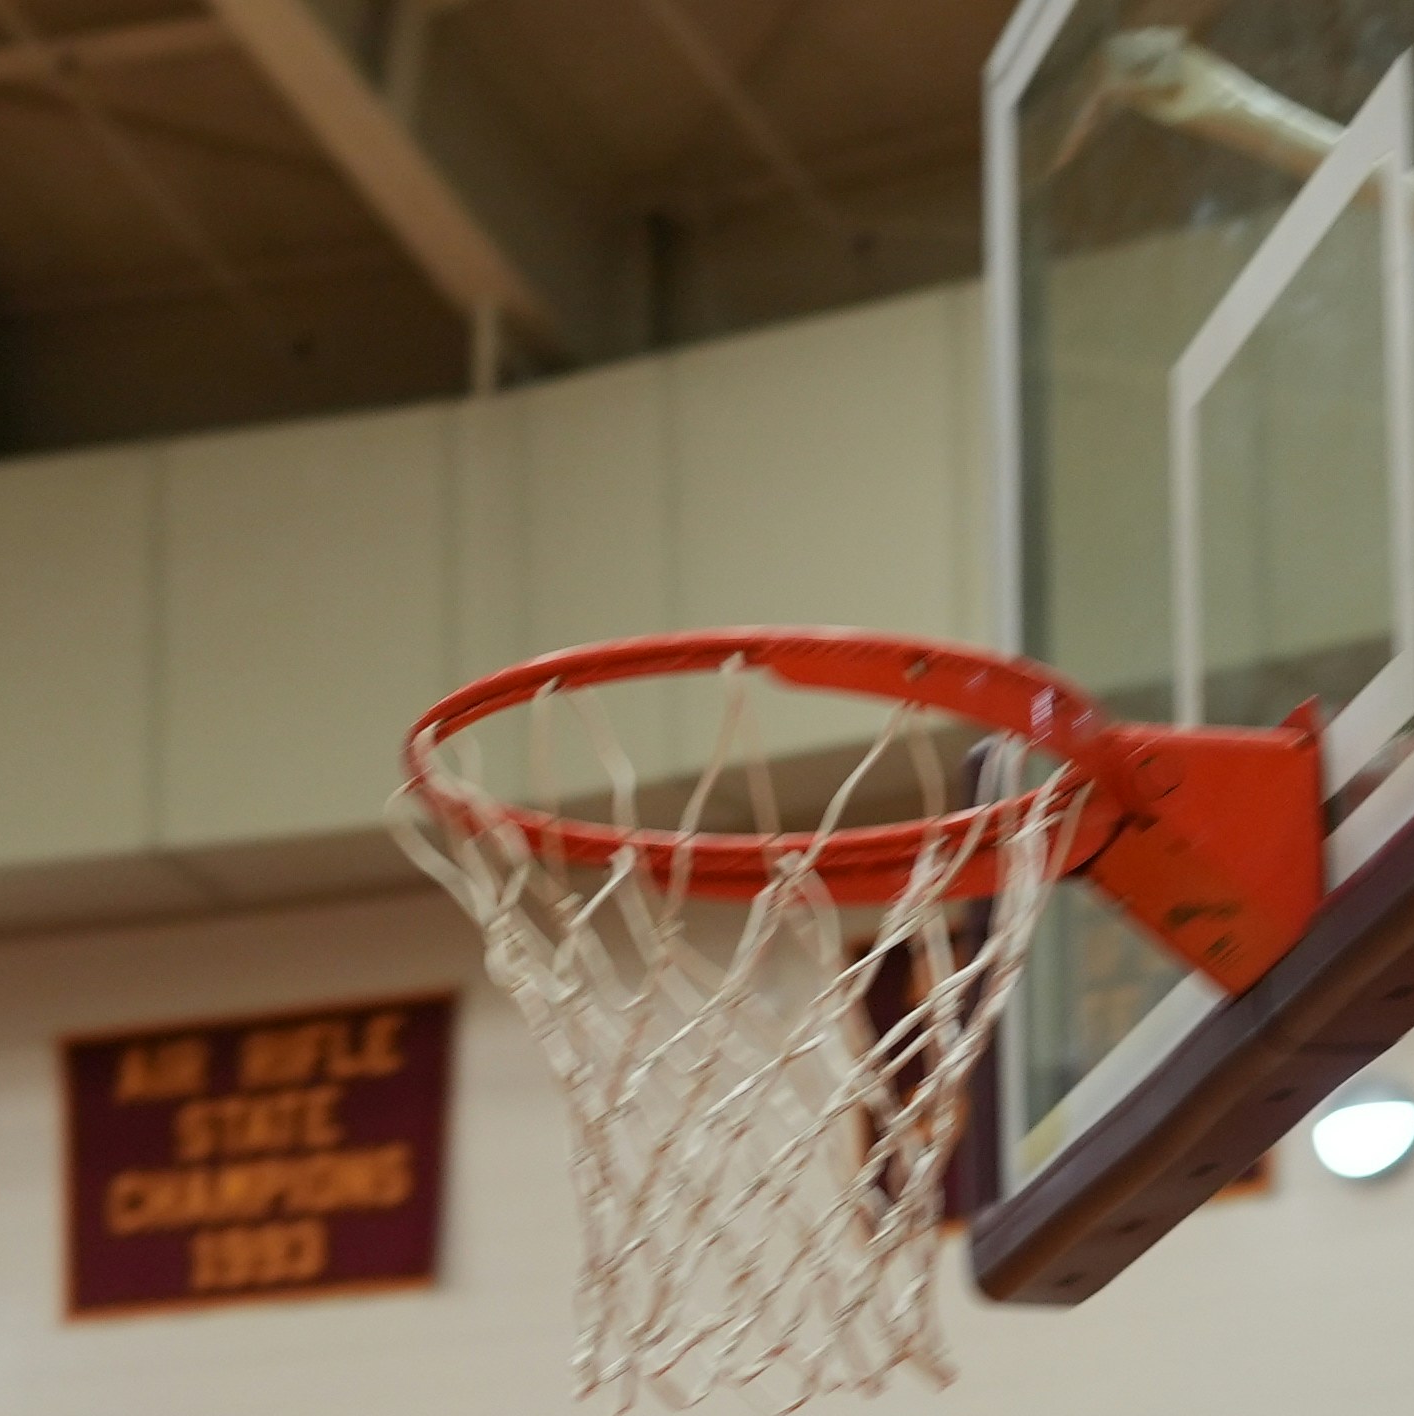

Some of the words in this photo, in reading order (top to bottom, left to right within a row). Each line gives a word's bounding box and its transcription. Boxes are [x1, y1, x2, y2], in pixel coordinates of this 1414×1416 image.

[116, 1038, 207, 1101] AIR
[241, 1015, 404, 1085] RIFLE
[175, 1088, 341, 1160] STATE
[108, 1144, 412, 1233] CHAMPIONS
